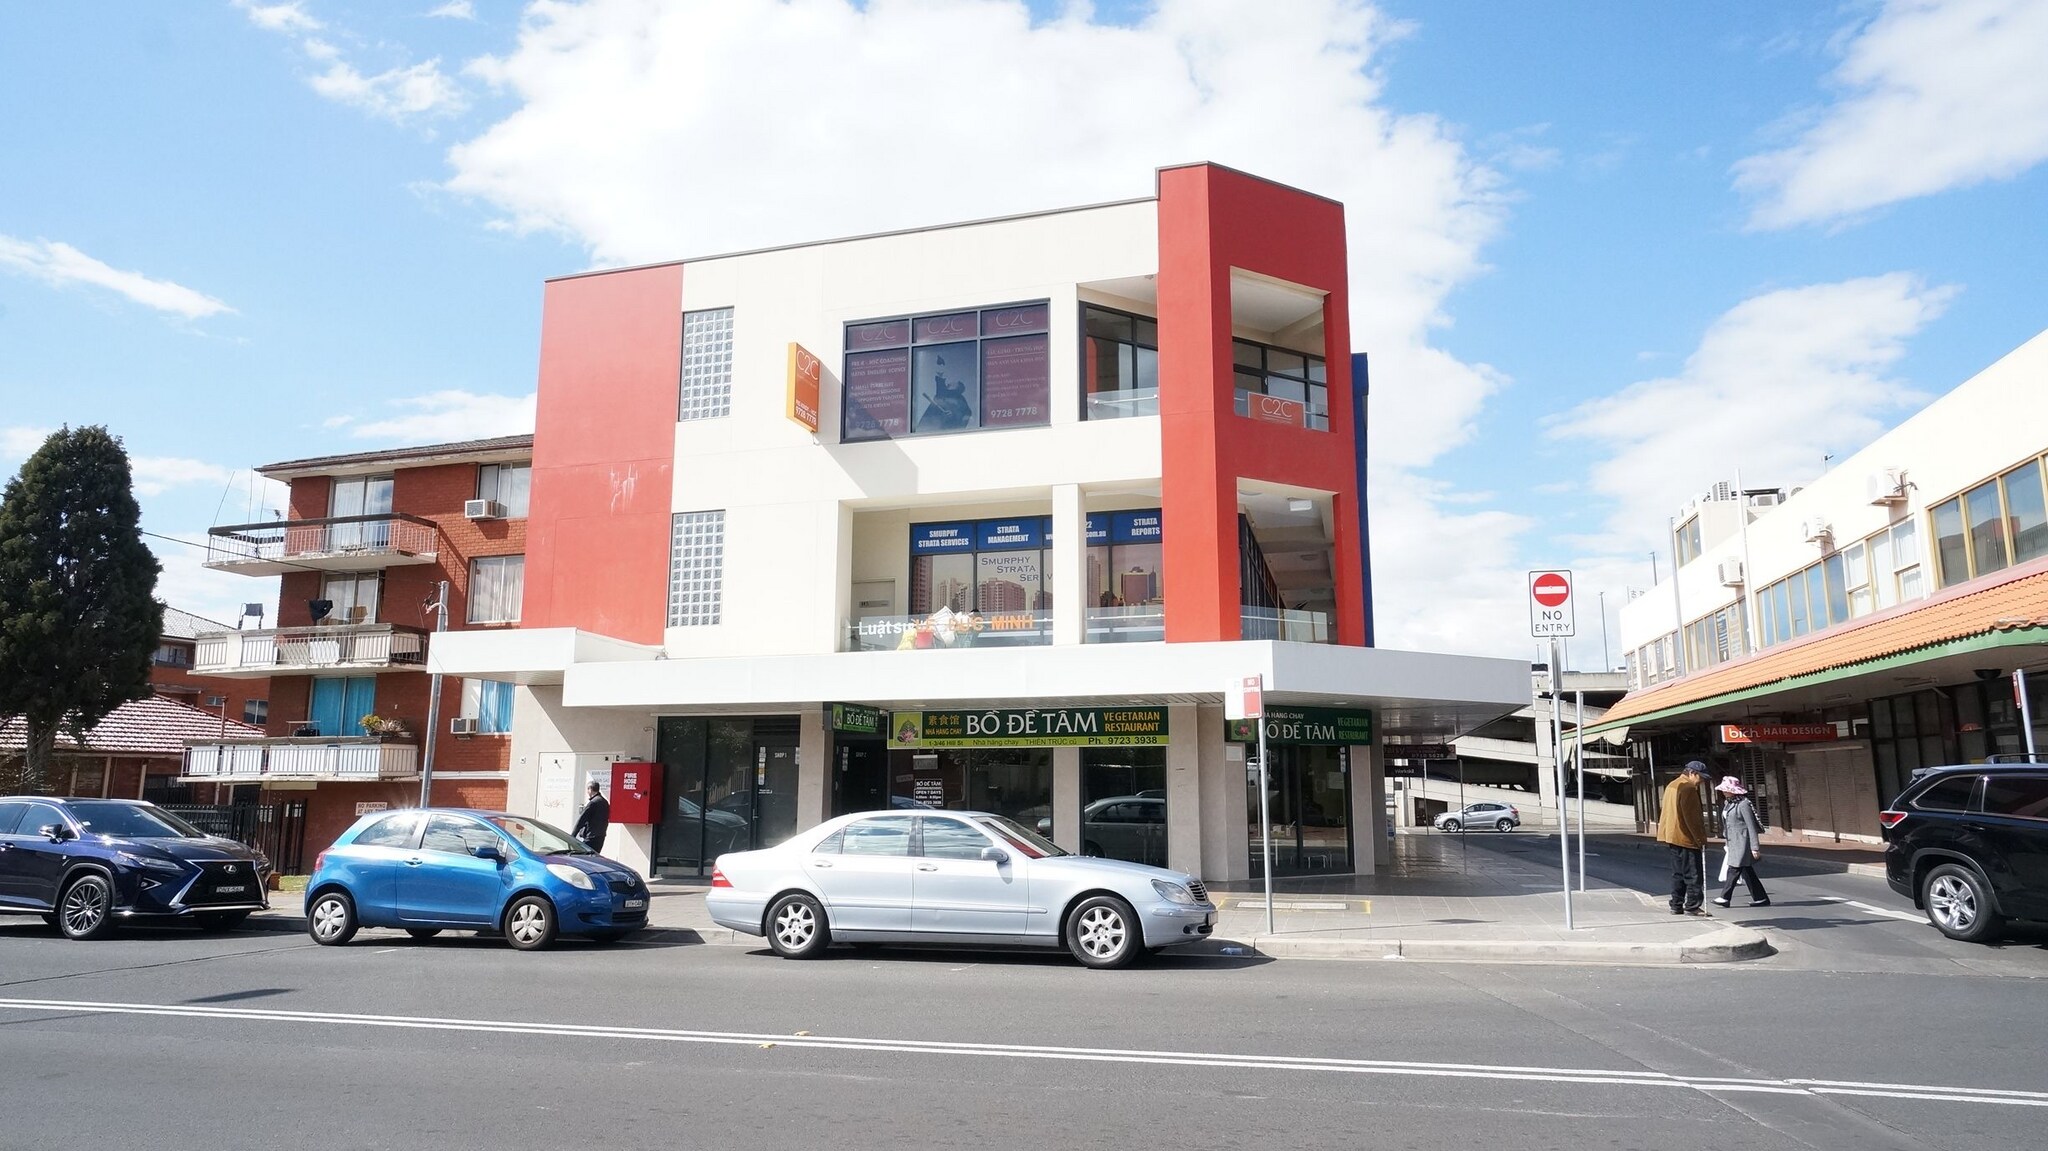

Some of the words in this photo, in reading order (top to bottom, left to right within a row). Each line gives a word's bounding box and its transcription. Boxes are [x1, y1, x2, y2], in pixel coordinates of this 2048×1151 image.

[995, 307, 1033, 327] C2C
[797, 350, 819, 381] C2C
[991, 408, 1013, 418] 9728
[1015, 406, 1038, 417] 7778
[1261, 397, 1293, 418] C2C
[879, 418, 900, 427] 7778
[1133, 517, 1158, 526] STRATA
[929, 529, 959, 538] SMURPHY
[997, 525, 1020, 534] STRATA
[1131, 526, 1161, 536] REPORTS
[918, 539, 940, 548] STRATA
[940, 537, 969, 547] SERVICES
[987, 533, 1029, 544] MANAGEMENT
[981, 556, 1031, 566] SMURPHY
[996, 565, 1036, 574] STRATA
[1542, 610, 1562, 621] NO
[991, 614, 1034, 630] MINH
[1535, 623, 1571, 632] ENTRY
[1103, 711, 1160, 721] VEGETARIAN
[966, 709, 1001, 735] BỒ
[1006, 709, 1040, 734] ĐỀ
[1041, 710, 1098, 733] TÂM
[1105, 722, 1160, 732] RESTAURANT
[1337, 717, 1368, 727] VEGETARIAN
[1265, 719, 1279, 739] Ồ
[1303, 723, 1336, 740] TÂM
[1763, 727, 1787, 736] HAIR
[1791, 725, 1831, 735] DESIGN
[1338, 730, 1368, 740] RESTAURANT
[1108, 737, 1131, 745] 9723
[1134, 736, 1158, 744] 3938
